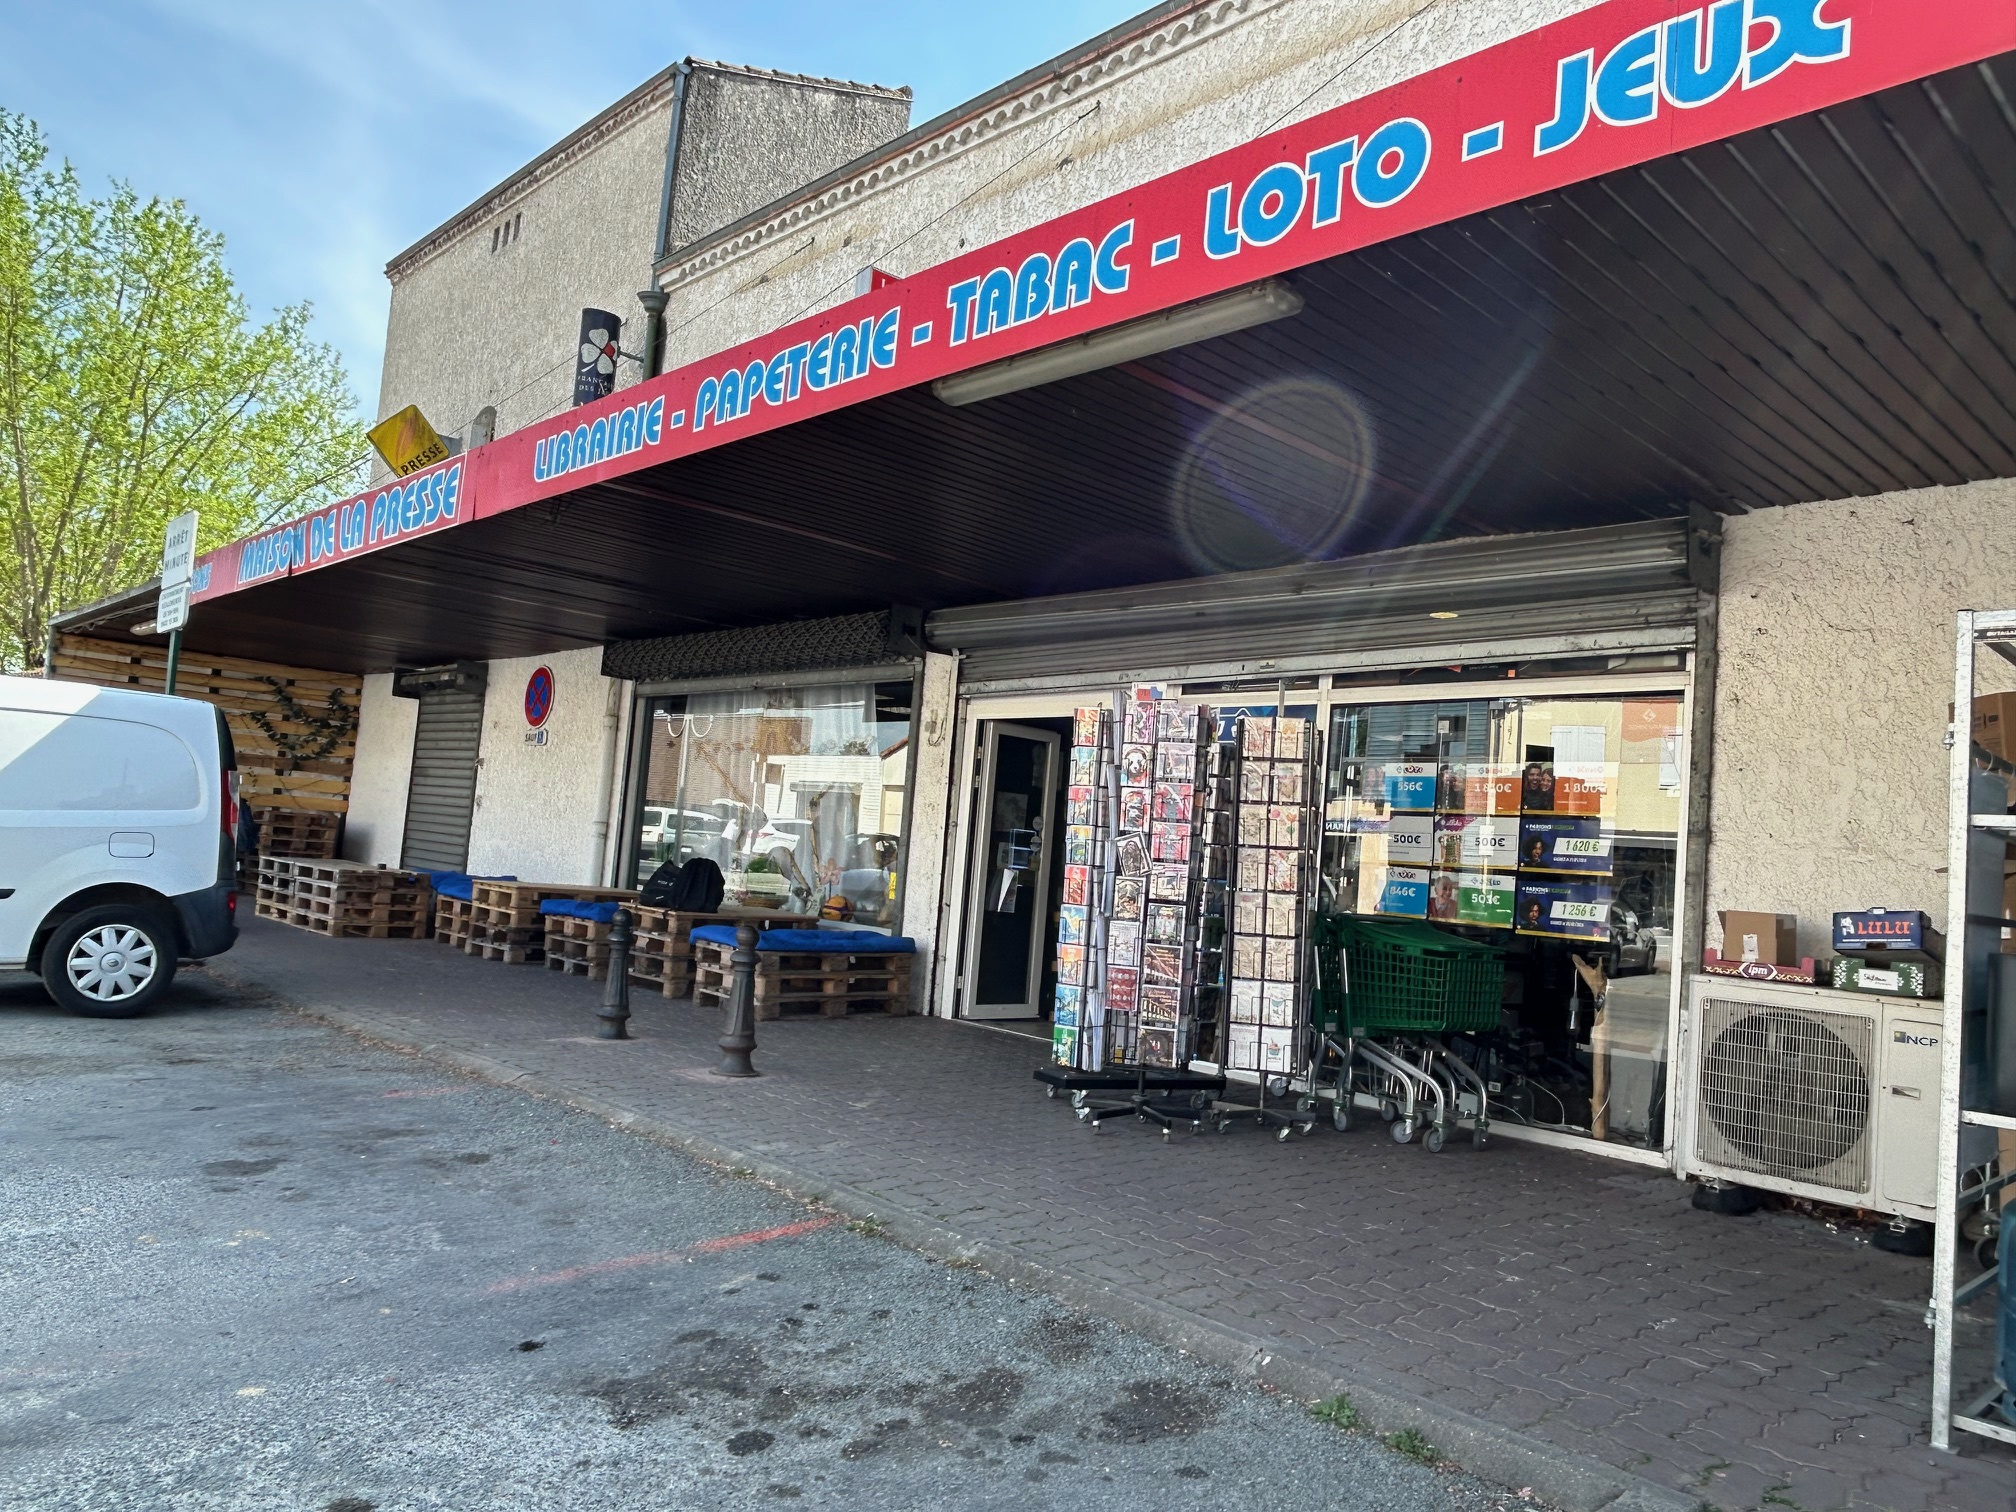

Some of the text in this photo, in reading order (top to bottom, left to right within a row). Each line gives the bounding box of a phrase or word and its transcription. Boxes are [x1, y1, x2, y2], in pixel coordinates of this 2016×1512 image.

[533, 0, 1851, 483] LIBRAIRIE - PAPETERIE - TABAC - LOTO - JEUX
[400, 443, 443, 475] PRESSE
[237, 520, 307, 585] MAISON
[310, 507, 338, 564] DE
[339, 499, 367, 554] LA
[369, 462, 461, 544] PRESSE
[168, 529, 189, 549] ARRÊT
[164, 551, 189, 572] MINUTE
[1393, 834, 1422, 844] 500€
[1475, 837, 1506, 847] 500€
[1572, 840, 1590, 852] 620
[1592, 841, 1600, 852] €
[1568, 904, 1587, 917] 256
[1589, 907, 1597, 917] €
[1858, 921, 1911, 935] LULU
[1906, 1035, 1939, 1047] NCP
